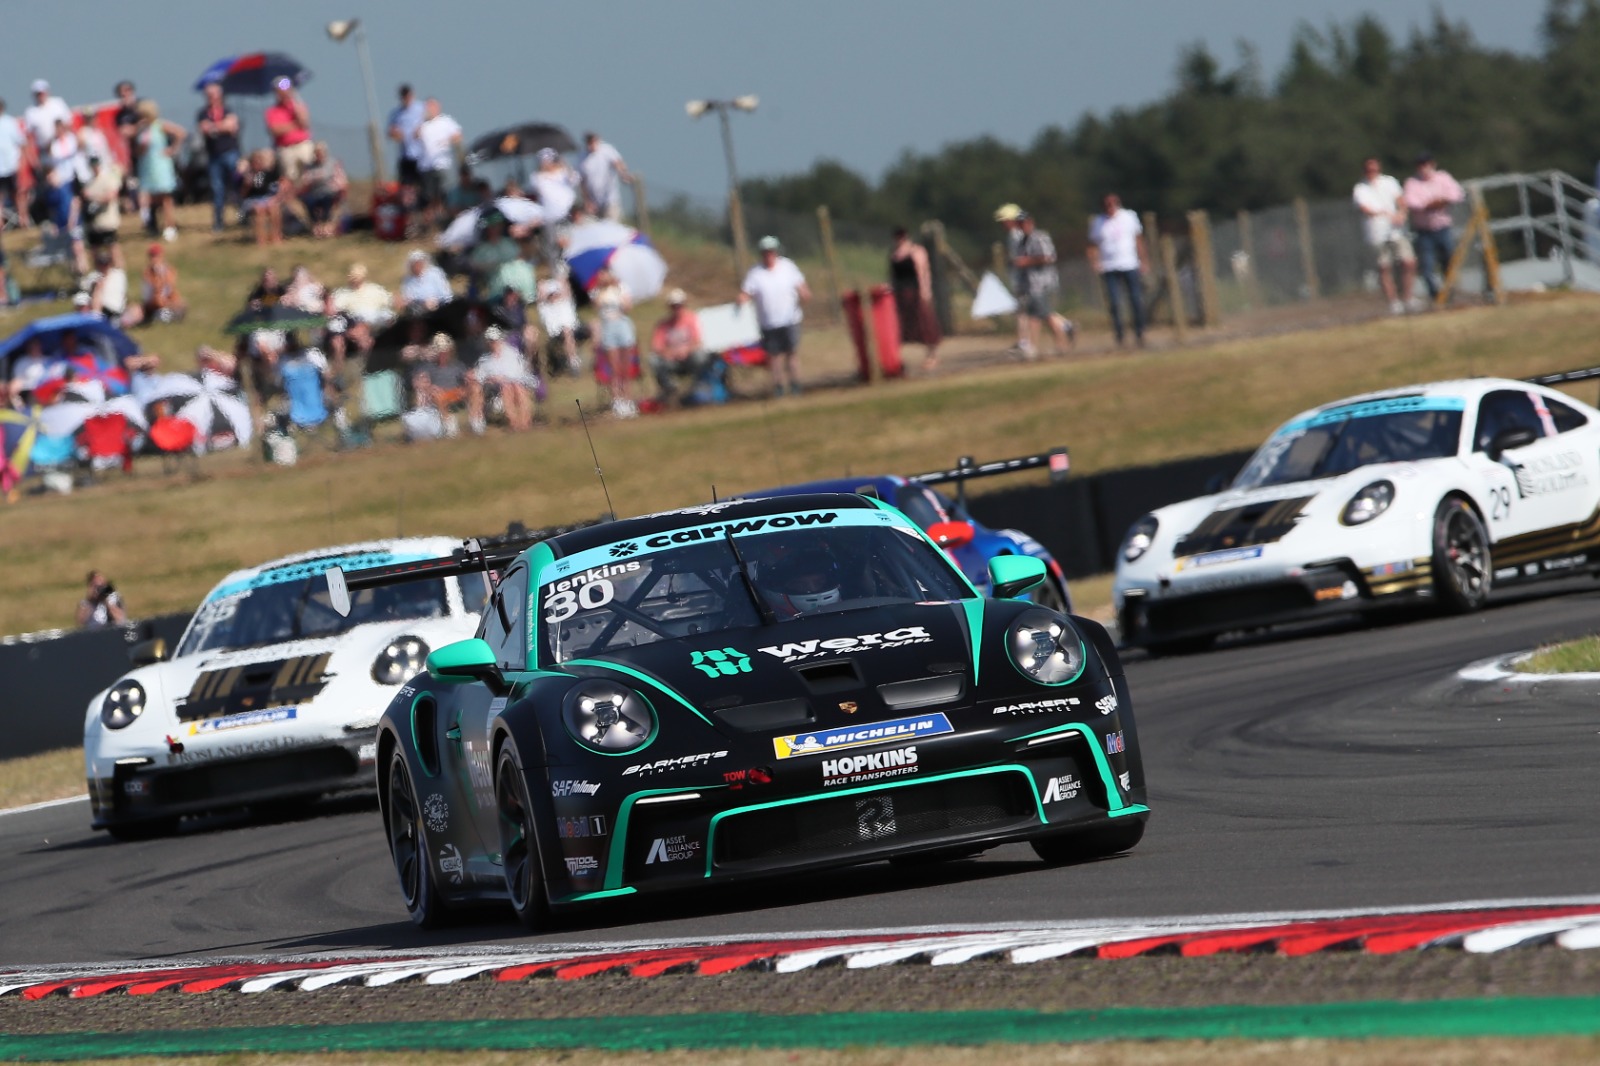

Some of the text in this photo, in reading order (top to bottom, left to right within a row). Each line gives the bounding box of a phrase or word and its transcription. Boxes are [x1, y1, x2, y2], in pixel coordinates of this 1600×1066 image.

[646, 512, 838, 549] carwow
[544, 560, 641, 600] Jenkins
[543, 579, 614, 624] 30
[992, 697, 1081, 715] BARKER'S
[1011, 706, 1072, 717] FINANCE
[825, 720, 934, 745] MICHELIN
[621, 750, 729, 776] BARKER'S
[639, 760, 709, 778] FINANCE
[821, 746, 918, 777] HOPKINS
[722, 769, 747, 782] TOW
[823, 765, 919, 787] RACE TRANSPORTERS
[1058, 774, 1073, 785] ASSET
[1059, 780, 1082, 793] ALLIANCE
[1060, 789, 1078, 801] GROUP
[557, 816, 591, 838] Mobil
[665, 835, 687, 845] ASSET
[666, 841, 701, 854] ALLIANCE
[667, 850, 694, 862] GROUP
